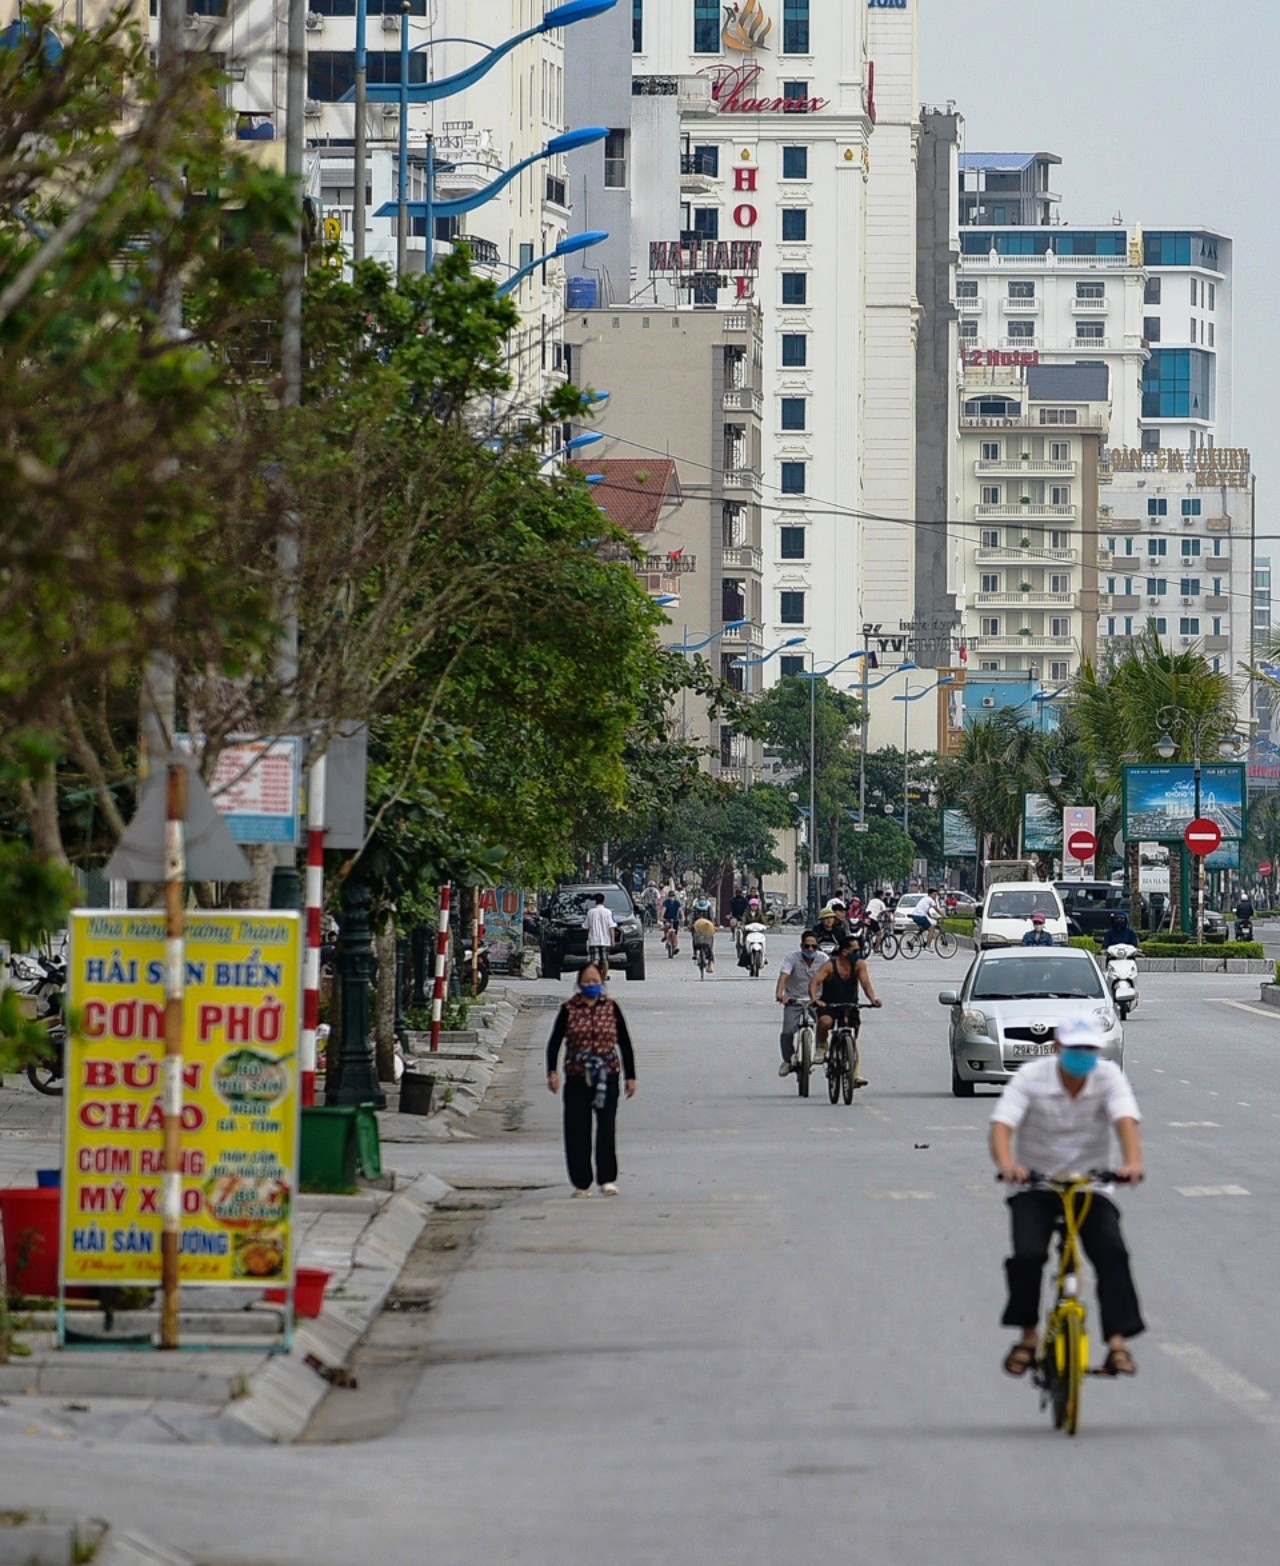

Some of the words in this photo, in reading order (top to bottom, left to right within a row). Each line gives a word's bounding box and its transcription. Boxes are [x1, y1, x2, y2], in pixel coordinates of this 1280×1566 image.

[696, 64, 831, 113] Phoenix
[987, 349, 1038, 367] Hotel
[1196, 472, 1248, 487] HOTEL
[182, 921, 233, 943] rường
[86, 949, 137, 984] HẢI
[147, 959, 205, 986] SN
[215, 949, 282, 987] BIỂN
[199, 995, 283, 1043] PHỞ
[78, 1146, 131, 1175] CƠM
[140, 1188, 202, 1213] XO
